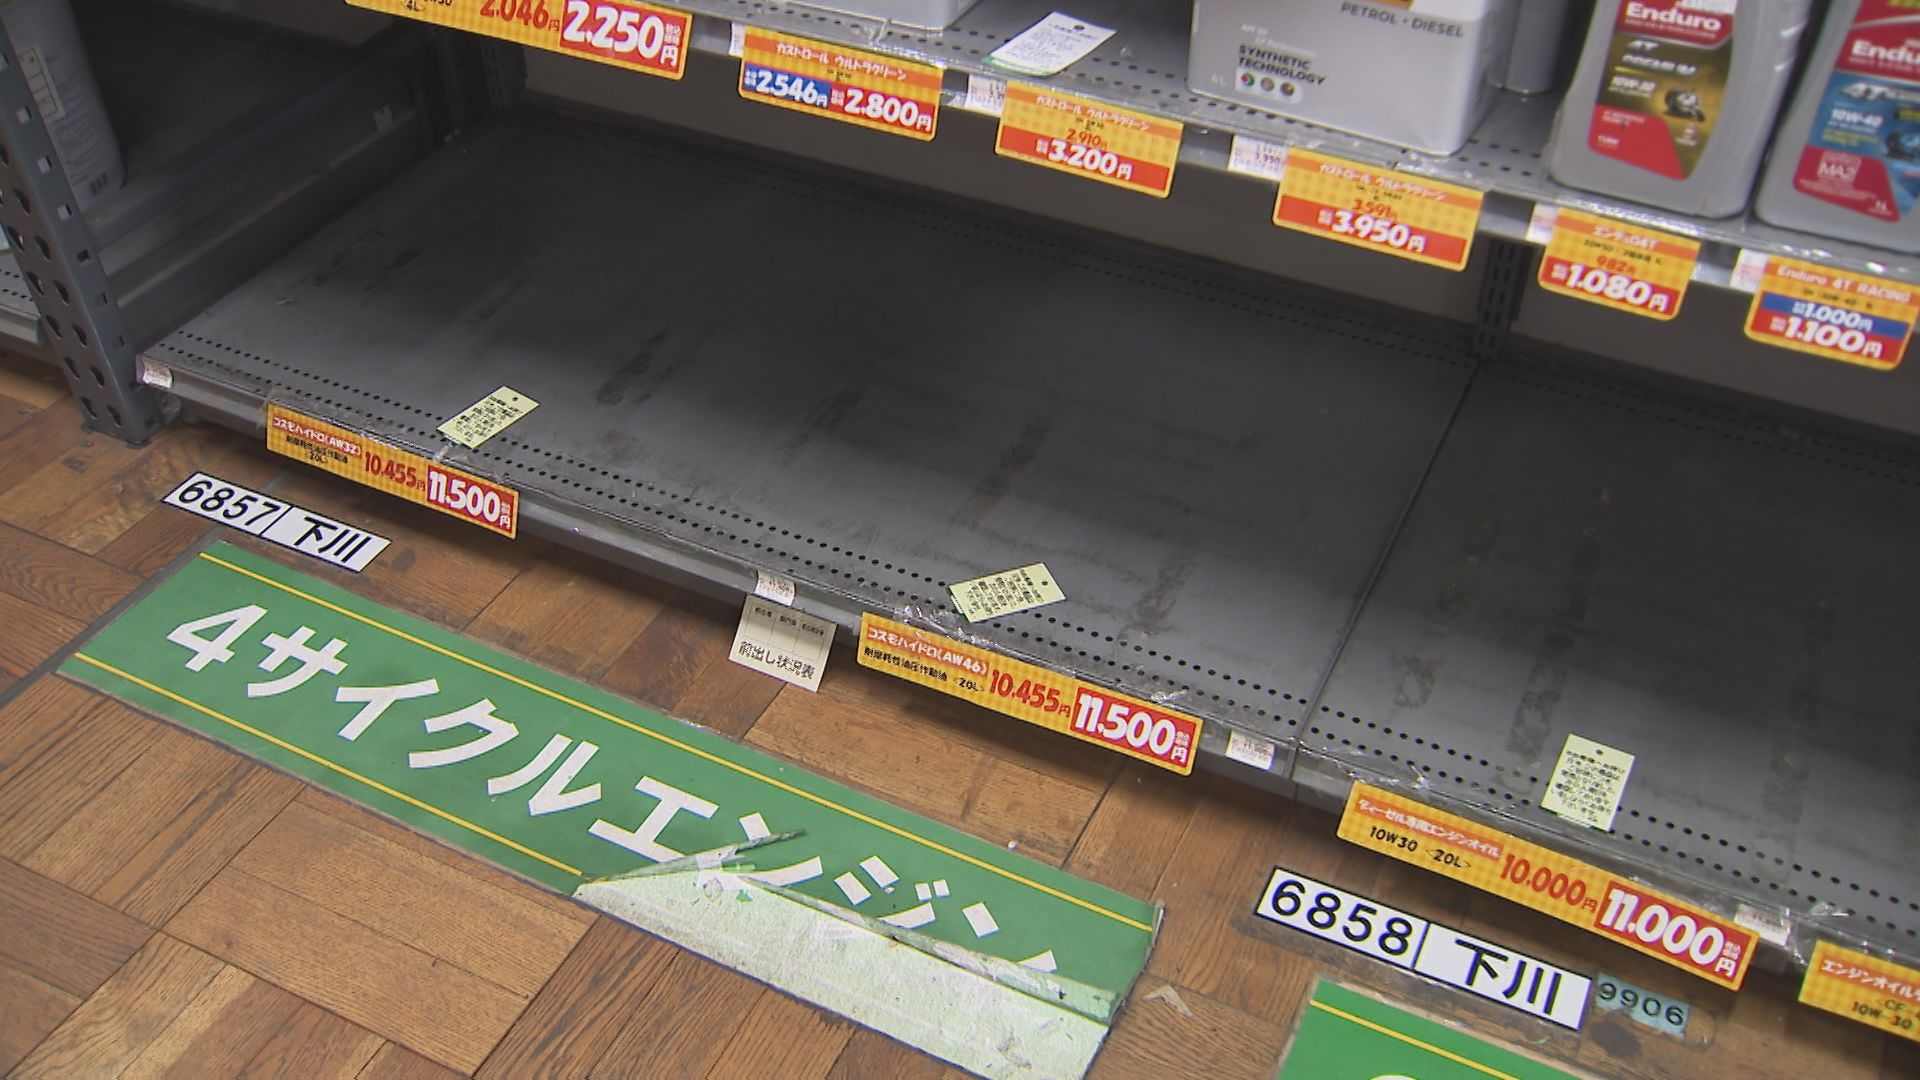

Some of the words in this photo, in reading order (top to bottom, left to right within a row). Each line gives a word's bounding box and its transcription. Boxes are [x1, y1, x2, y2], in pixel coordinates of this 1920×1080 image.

[1340, 2, 1397, 25] PETROL
[1410, 18, 1464, 38] DIESEL
[1626, 2, 1721, 31] Enduro
[1238, 57, 1326, 86] TECHNOLOGY
[1239, 44, 1311, 70] SYNTHETIC
[1777, 265, 1828, 286] Enduro
[1857, 282, 1912, 304] RACING
[178, 479, 281, 527] 6857
[293, 516, 371, 564] 下川
[739, 640, 816, 680] 前出し状況表
[1369, 825, 1418, 852] 10W30
[1270, 878, 1414, 957] 6858
[1454, 937, 1563, 1016] 下川
[1598, 981, 1685, 1027] 9906
